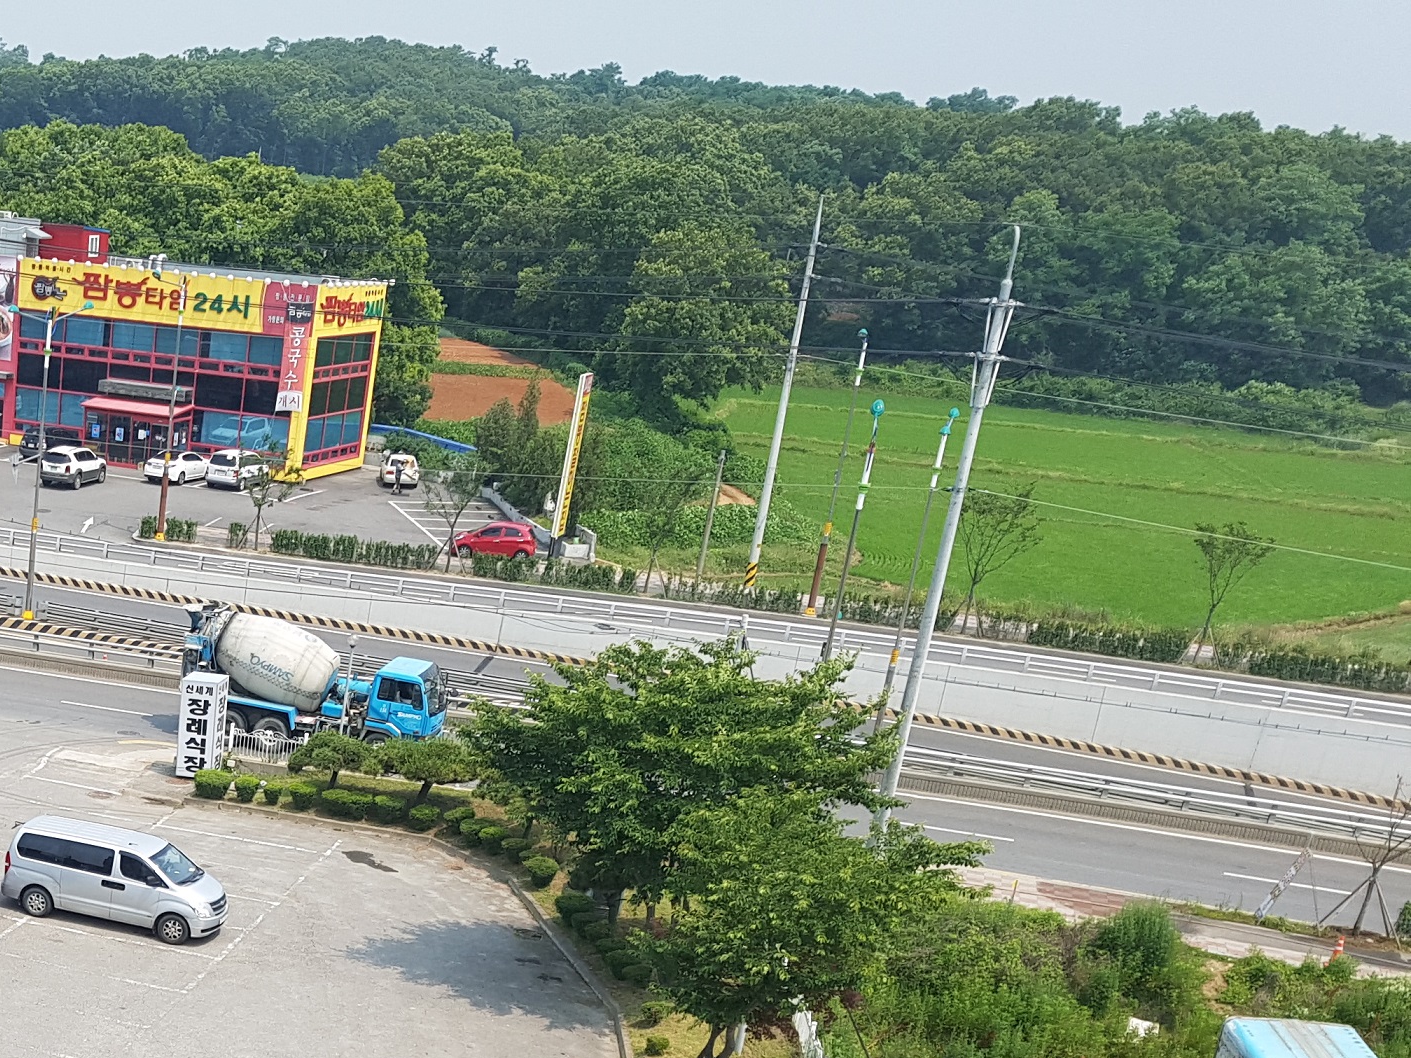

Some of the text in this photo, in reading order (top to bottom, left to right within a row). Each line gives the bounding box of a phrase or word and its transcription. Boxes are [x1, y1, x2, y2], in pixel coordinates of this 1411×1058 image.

[72, 271, 251, 320] 짬뽕타임 24시
[283, 326, 306, 391] 콩국수
[278, 394, 301, 410] 개시
[185, 684, 214, 696] 신세계
[183, 698, 212, 774] 장례식장
